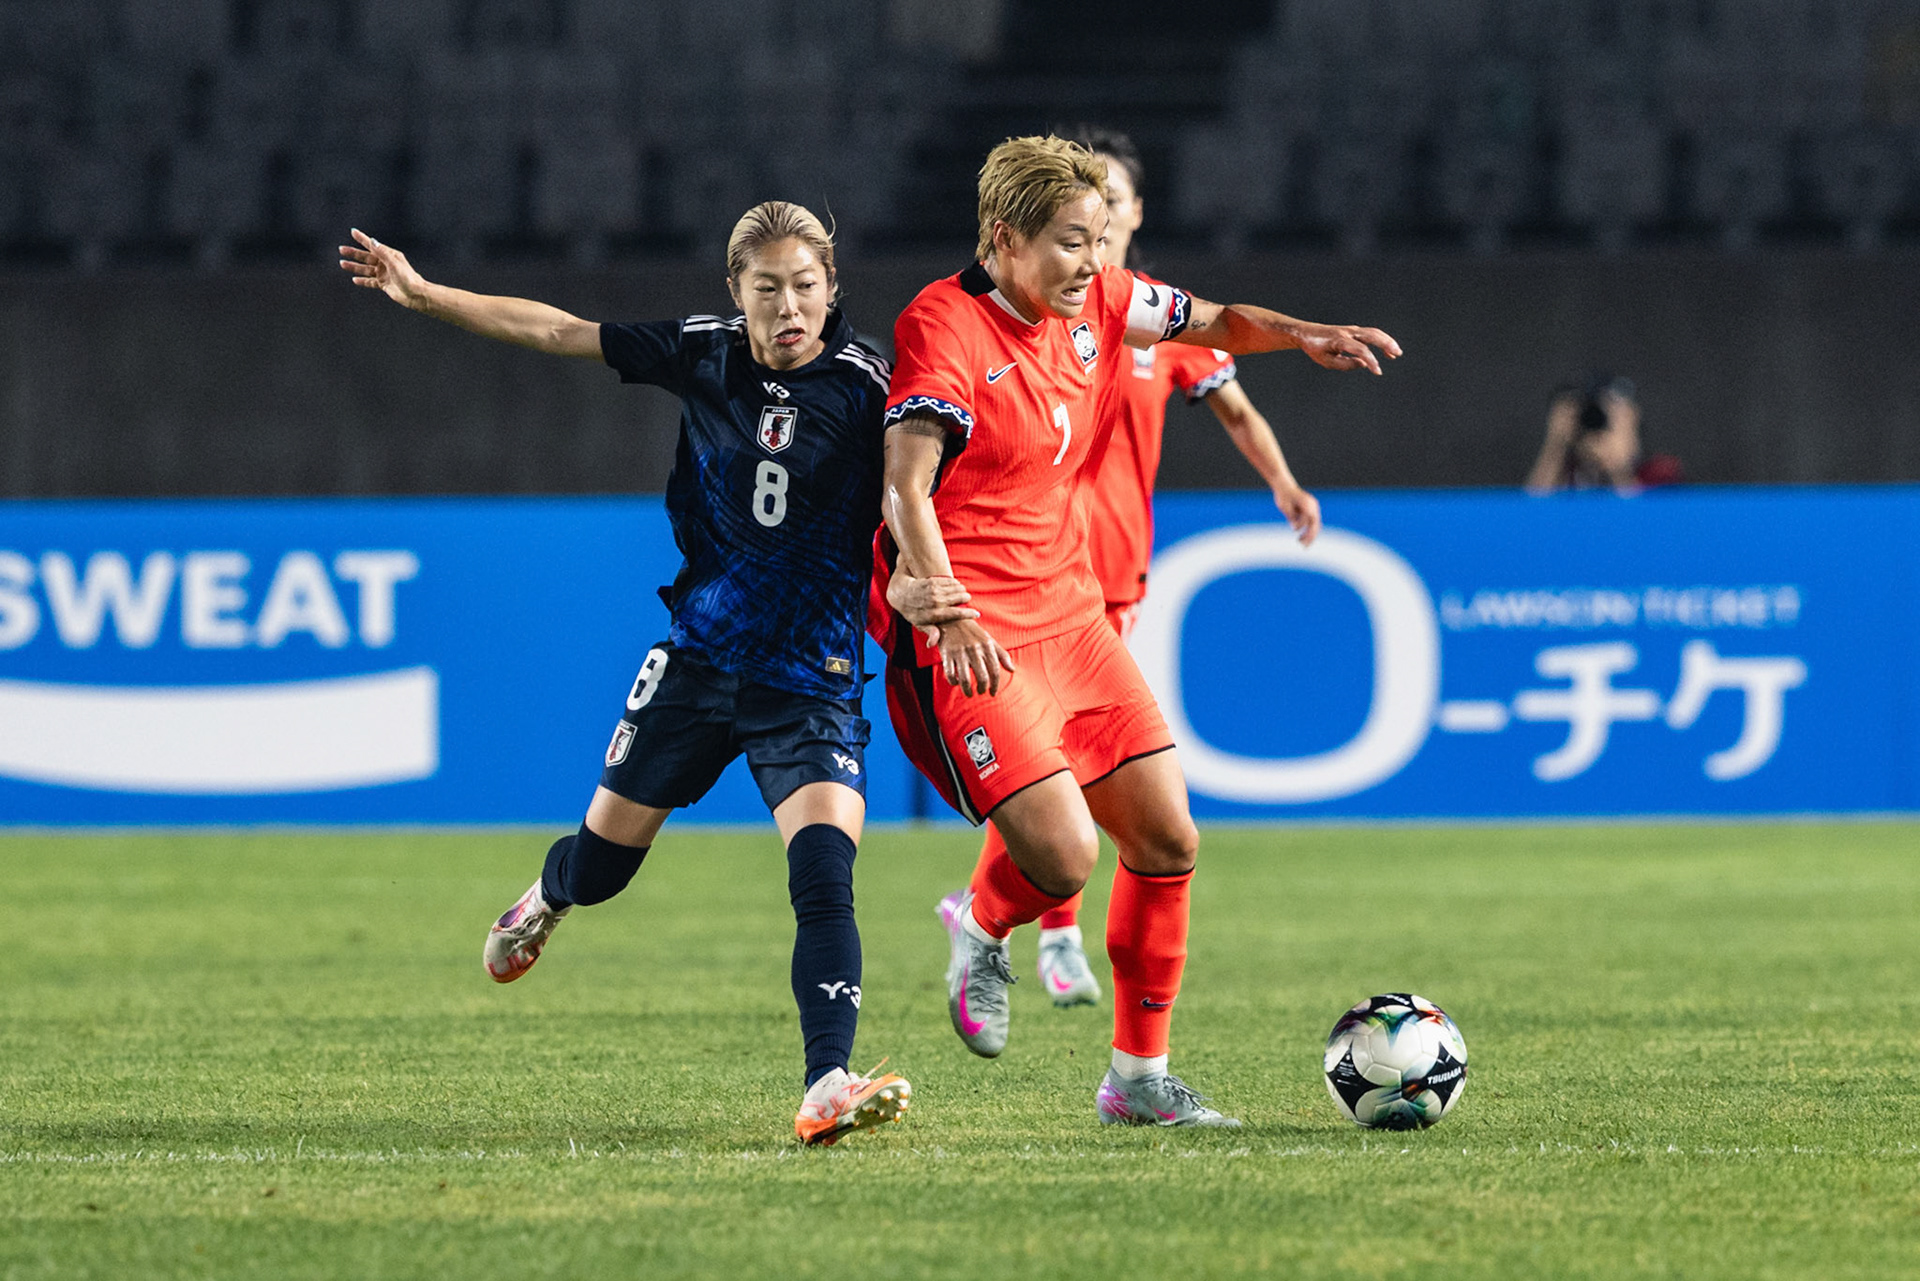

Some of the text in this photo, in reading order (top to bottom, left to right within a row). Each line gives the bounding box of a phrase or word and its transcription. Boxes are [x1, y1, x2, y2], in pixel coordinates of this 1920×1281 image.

[762, 381, 790, 399] Y-3
[1053, 402, 1072, 466] 7
[752, 459, 789, 527] 8
[0, 549, 420, 649] SWEAT
[626, 648, 669, 711] 8
[832, 753, 860, 775] Y-3
[817, 981, 862, 1009] Y-3
